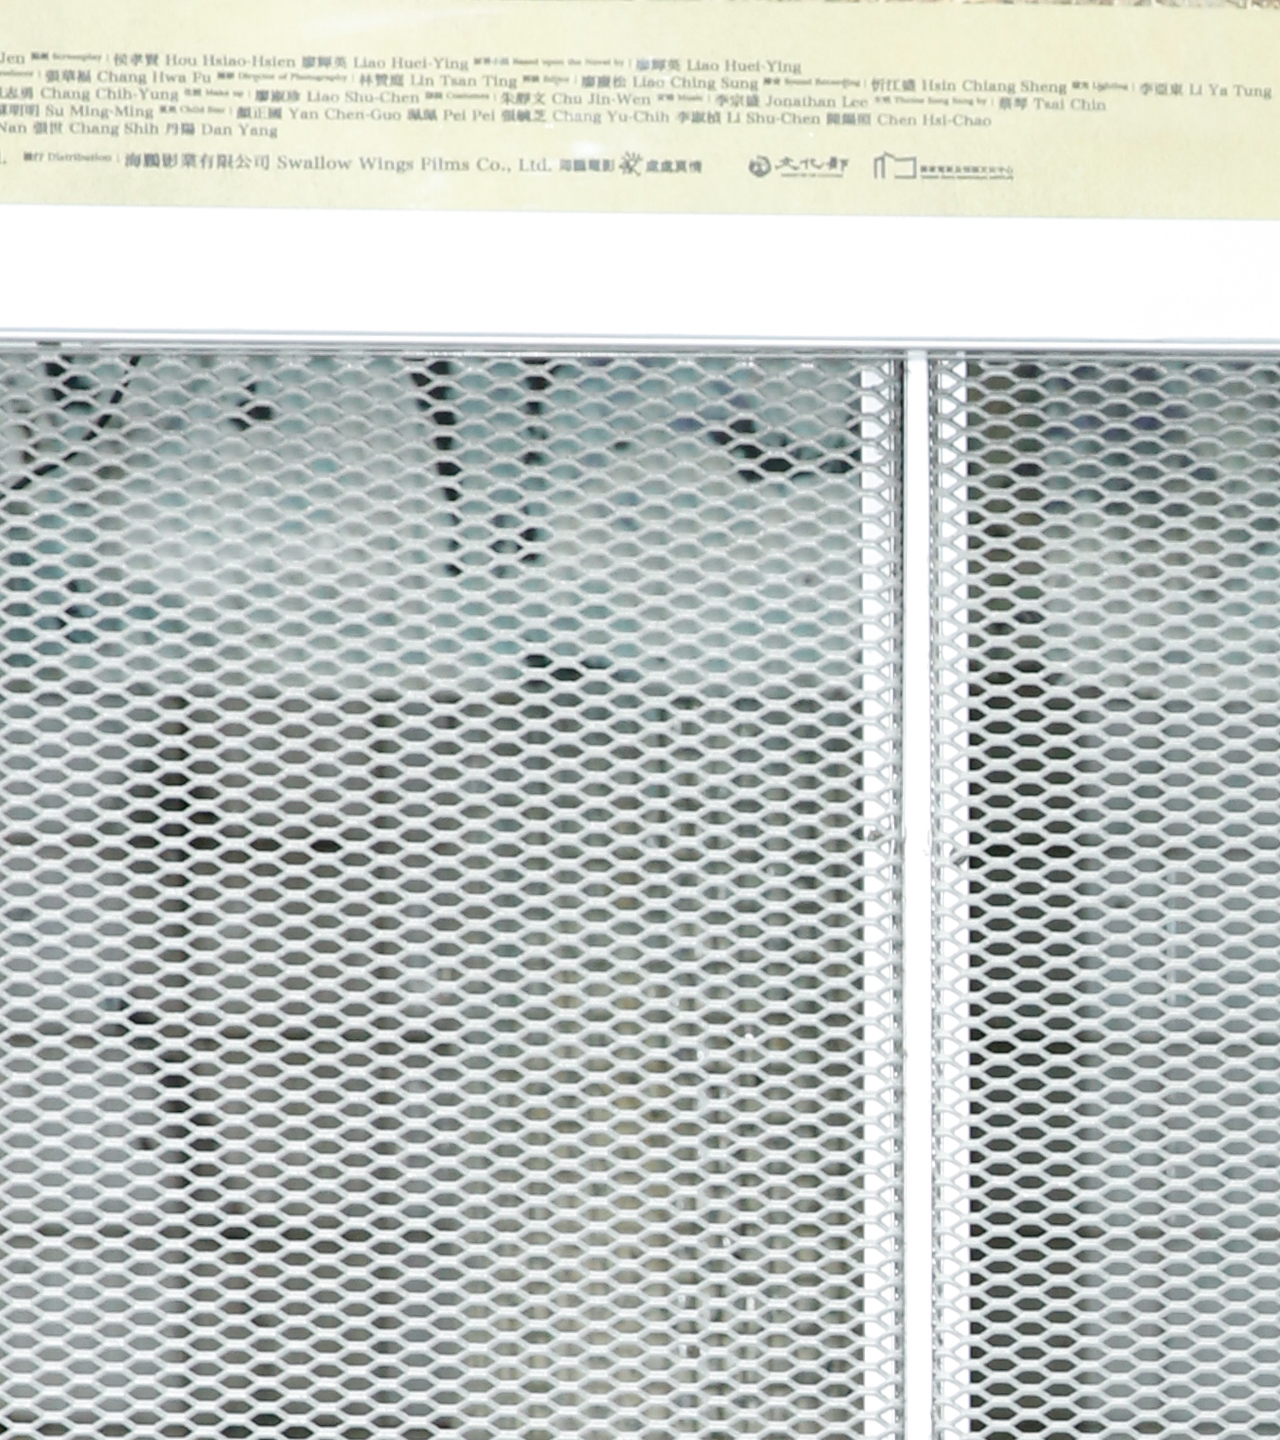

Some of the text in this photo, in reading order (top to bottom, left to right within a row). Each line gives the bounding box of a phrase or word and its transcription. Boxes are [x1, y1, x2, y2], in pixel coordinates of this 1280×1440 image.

[0, 52, 25, 65] Jen
[166, 54, 197, 66] Hou
[203, 54, 296, 68] Hsiao-Hsien
[354, 57, 386, 68] Liao
[392, 57, 468, 72] Huei-Ying
[687, 59, 719, 71] Liao
[725, 59, 802, 75] Huei-Ying
[97, 70, 147, 86] Chang
[153, 71, 186, 83] Hwa
[193, 71, 211, 84] Fu
[411, 74, 434, 87] Lin
[440, 75, 476, 87] Tsan
[482, 75, 517, 90] Ting
[633, 76, 665, 88] Liao
[670, 76, 716, 94] Ching
[721, 77, 759, 94] Sung
[922, 79, 956, 92] Hsin
[962, 79, 1017, 98] Chiang
[1019, 80, 1067, 99] Sheng
[1190, 83, 1202, 96] Li
[1209, 84, 1228, 96] Ya
[1233, 85, 1272, 100] Tung
[40, 87, 90, 102] Chang
[95, 85, 178, 102] Chih-Yung
[307, 91, 339, 102] Liao
[345, 91, 419, 104] Shu-Chen
[551, 93, 582, 104] Chu
[588, 93, 651, 105] Jin-Wen
[765, 95, 836, 108] Jonathan
[842, 96, 868, 108] Lee
[1033, 97, 1064, 110] Tsai
[1070, 98, 1106, 111] Chin
[45, 104, 64, 117] Su
[70, 105, 154, 120] Ming-Ming
[289, 107, 318, 119] Yan
[324, 108, 401, 121] Chen-Guo
[443, 109, 466, 121] Pei
[472, 110, 495, 121] Pei
[552, 110, 601, 124] Chang
[607, 110, 669, 123] Yu-Chih
[727, 111, 741, 124] Li
[746, 112, 820, 125] Shu-Chen
[877, 114, 916, 125] Chen
[923, 114, 991, 126] Hsi-Chao
[69, 121, 119, 137] Chang
[124, 122, 159, 135] Shih
[202, 123, 232, 136] Dan
[238, 123, 277, 139] Yang
[277, 155, 352, 170] Swallow
[359, 157, 413, 173] Wings
[421, 157, 469, 171] Films
[519, 158, 552, 172] Ltd.
